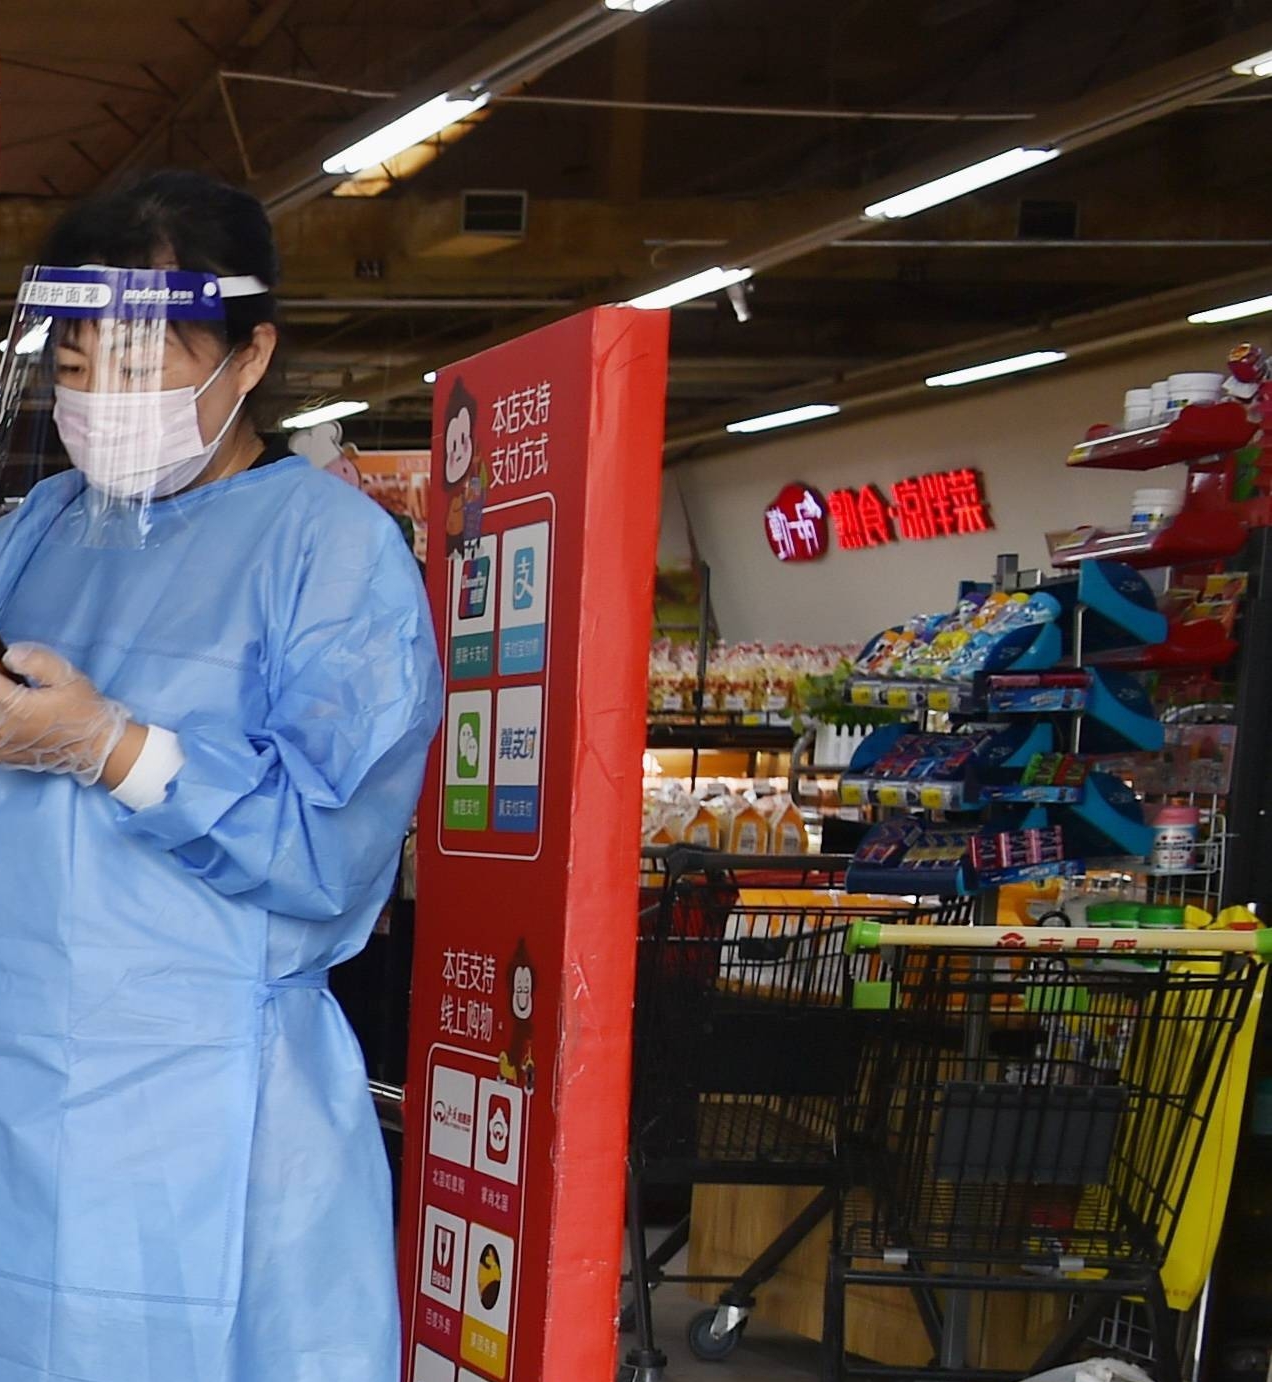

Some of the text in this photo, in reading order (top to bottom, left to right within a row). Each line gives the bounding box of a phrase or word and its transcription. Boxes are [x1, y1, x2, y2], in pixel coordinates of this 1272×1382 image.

[491, 381, 551, 437] 本店支持
[489, 435, 550, 489] 支付方式
[441, 947, 496, 995] 本店支持
[440, 993, 494, 1043] 线上购物
